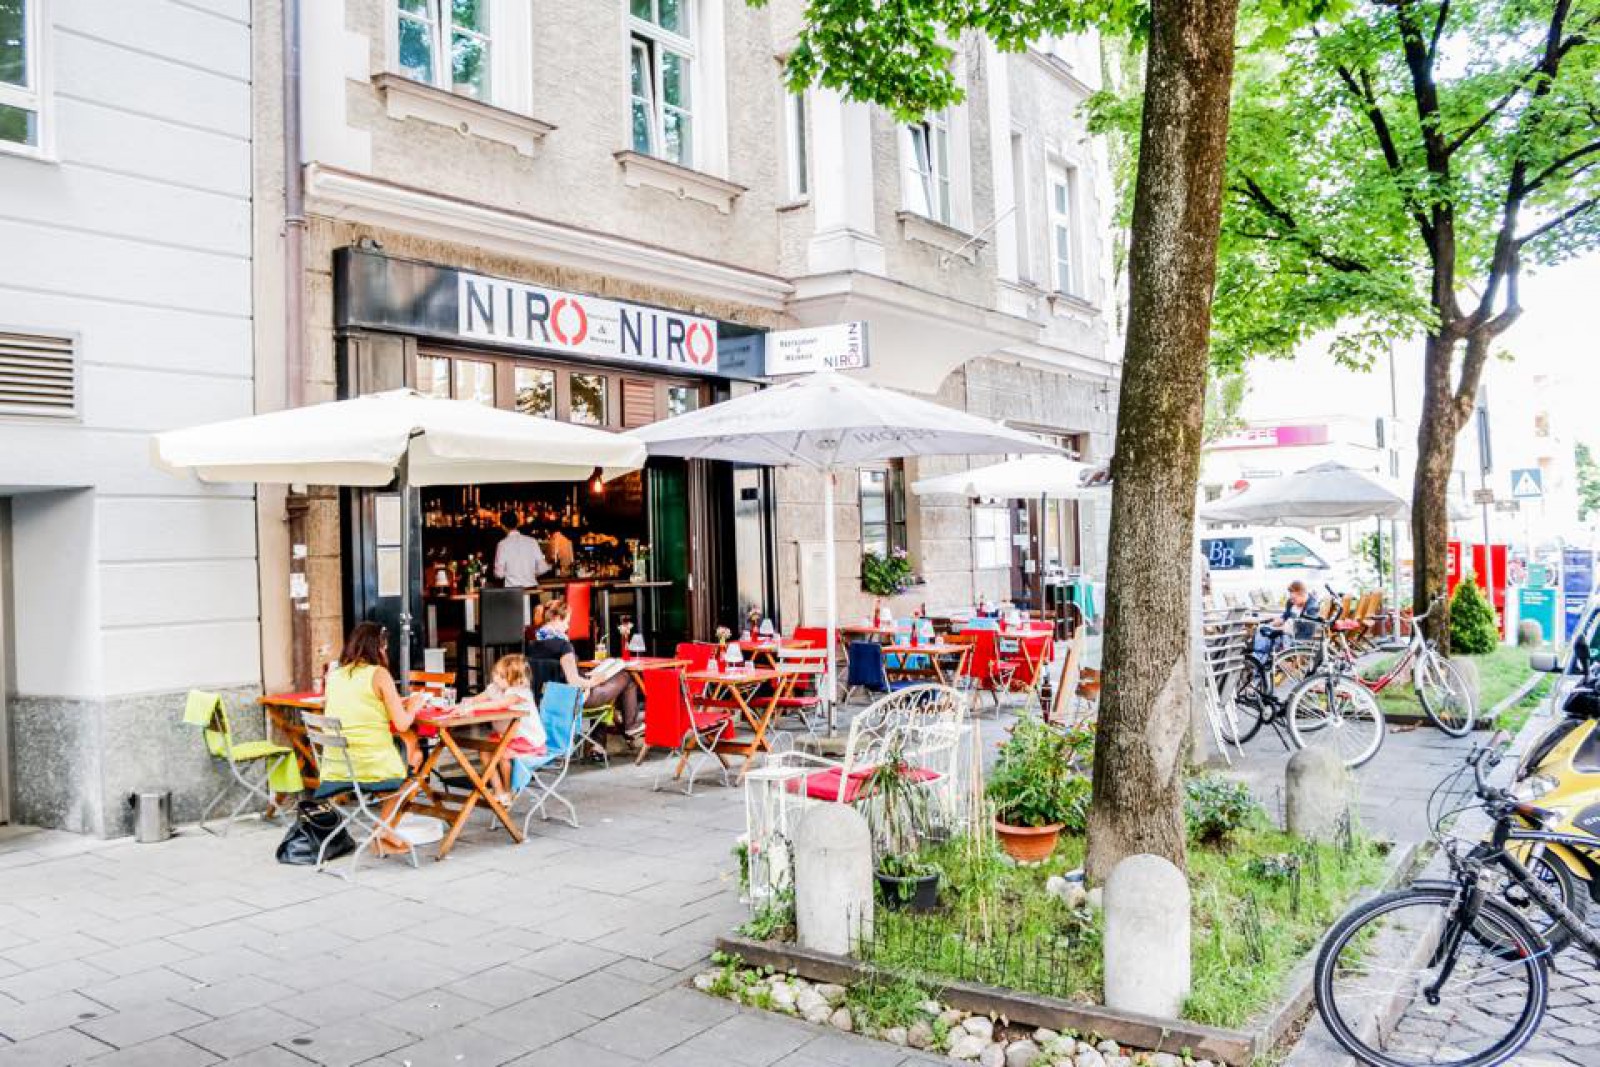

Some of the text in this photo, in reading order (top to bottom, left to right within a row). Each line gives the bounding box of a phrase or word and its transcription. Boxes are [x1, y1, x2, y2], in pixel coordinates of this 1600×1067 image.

[467, 280, 587, 345] NIRO
[621, 308, 714, 365] NIRO
[824, 354, 860, 367] NIRO
